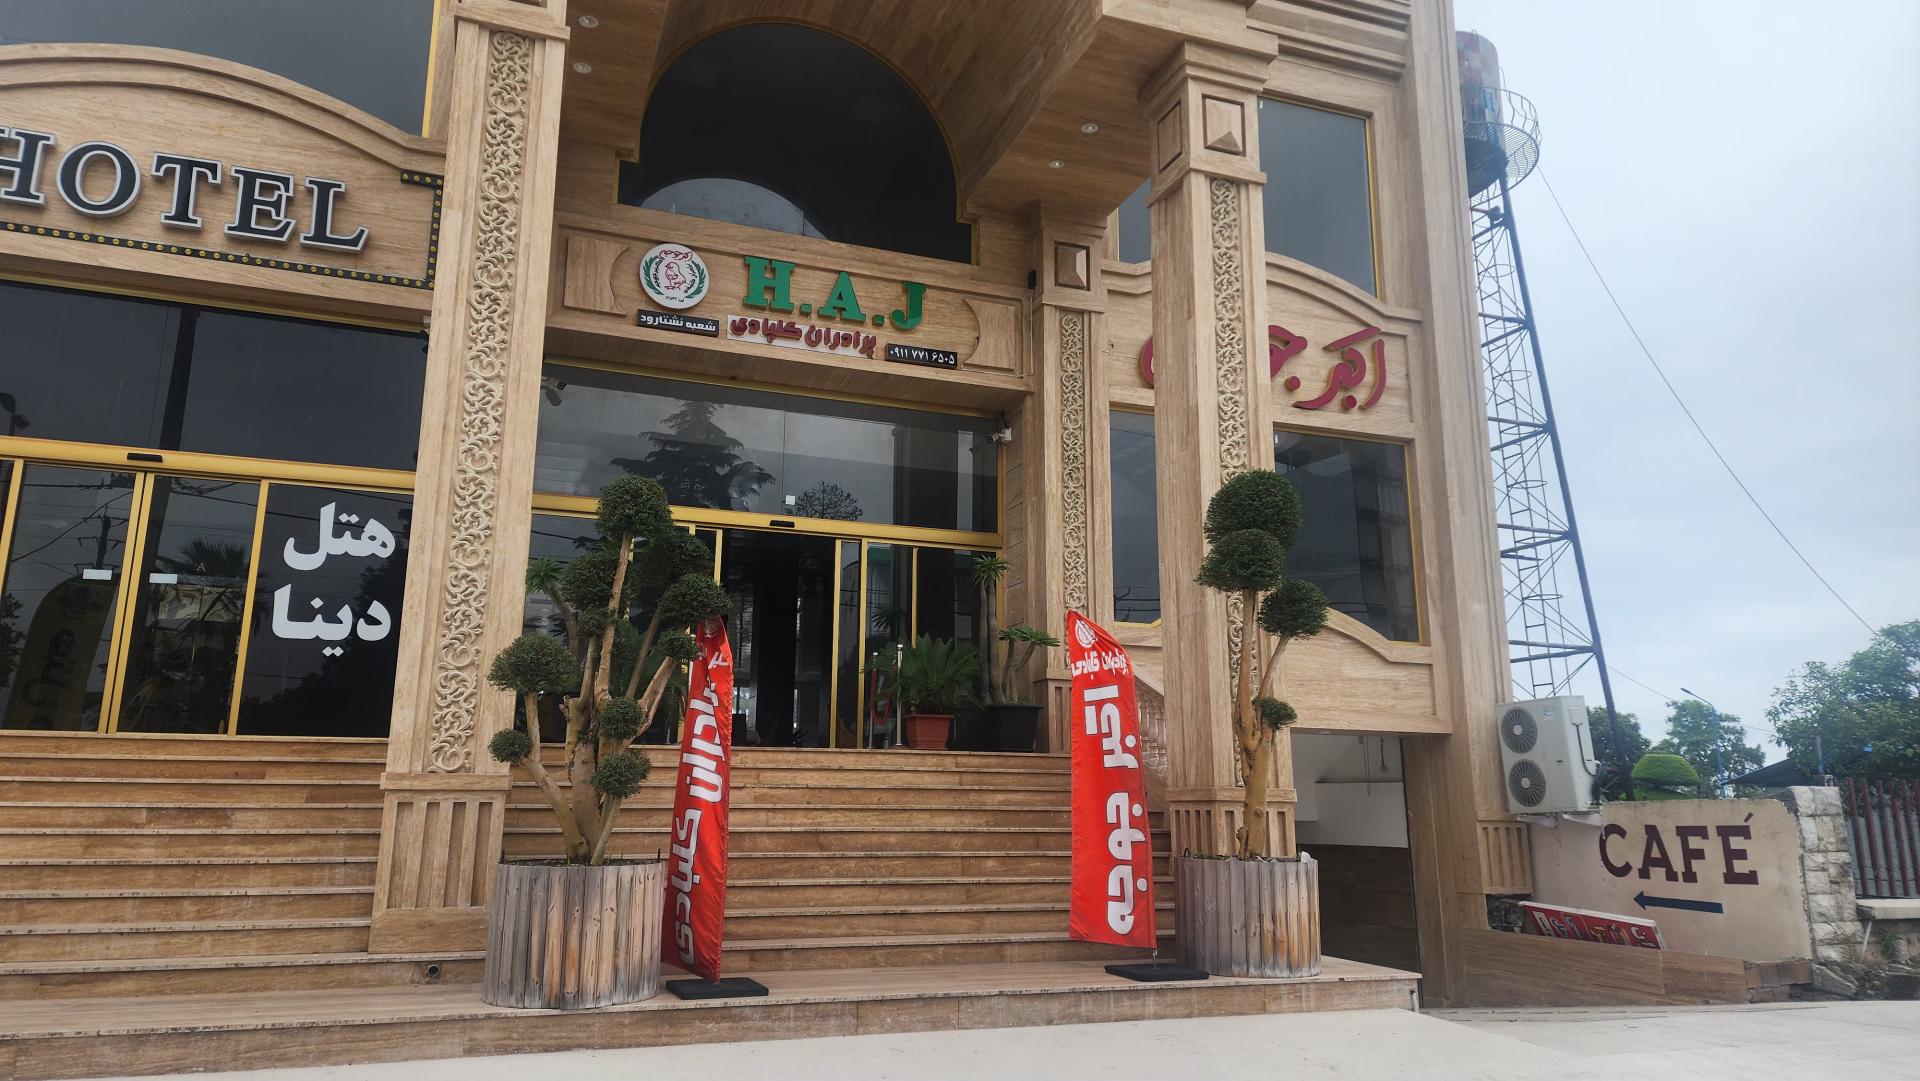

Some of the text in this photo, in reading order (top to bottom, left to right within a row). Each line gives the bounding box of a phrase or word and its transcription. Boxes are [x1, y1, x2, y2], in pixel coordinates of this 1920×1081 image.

[0, 126, 370, 252] HOTEL
[640, 313, 716, 332] شعبه نشتارود
[805, 325, 877, 359] برادران
[890, 347, 955, 364] ۰۹۱۱ ۷۷۱ ۶۵۰۵
[283, 501, 396, 571] هتل
[272, 584, 392, 657] دینا
[1083, 685, 1139, 769] اکبر
[1106, 791, 1148, 936] جوجه
[1600, 812, 1758, 885] CAFÉ
